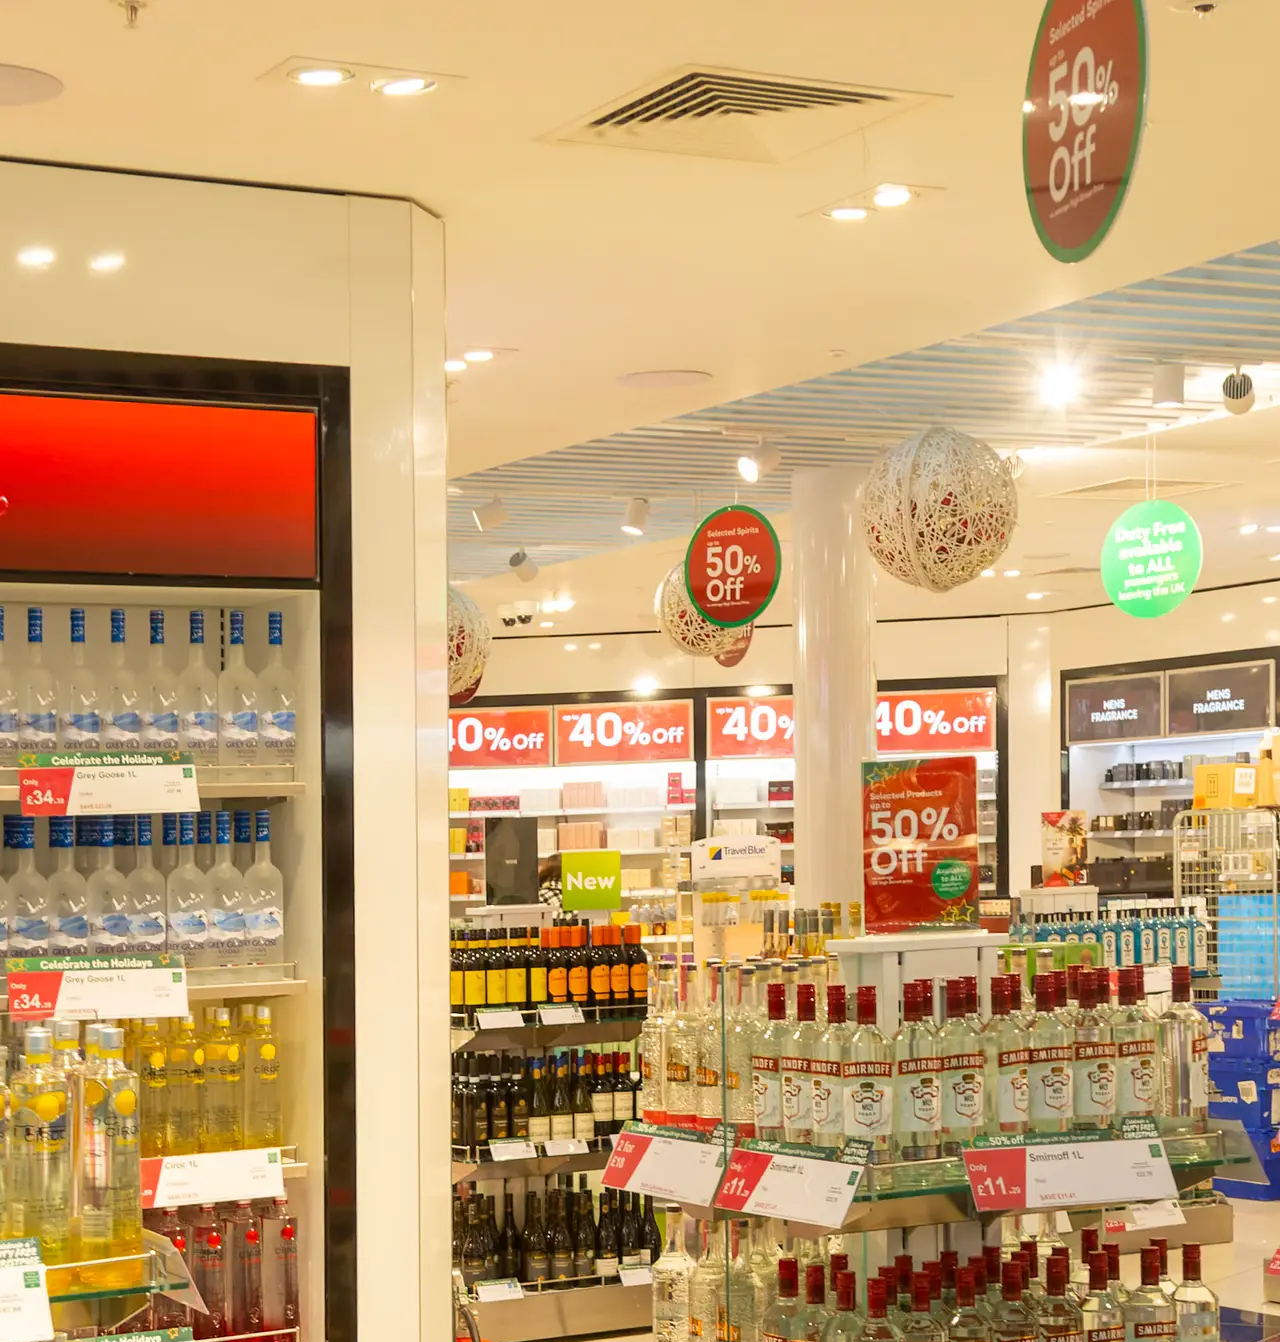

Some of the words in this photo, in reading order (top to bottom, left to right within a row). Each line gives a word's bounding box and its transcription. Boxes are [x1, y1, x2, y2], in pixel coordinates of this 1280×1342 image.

[1049, 6, 1086, 45] Selected
[1048, 46, 1119, 142] 50%
[1049, 124, 1097, 203] Off
[707, 528, 736, 538] Selected
[737, 526, 760, 537] Spirits
[706, 544, 761, 578] 50%
[1128, 562, 1145, 577] to
[1146, 555, 1176, 574] ALL
[706, 576, 745, 602] Off
[1206, 688, 1231, 701] MENS
[1103, 699, 1126, 710] MENS
[1193, 699, 1246, 714] FRAGRANCE
[1091, 709, 1138, 723] FRAGRANCE
[51, 756, 102, 767] Celebrate
[103, 756, 120, 765] the
[121, 755, 163, 766] Holidays
[76, 772, 96, 781] Grey
[98, 771, 126, 779] Goose
[23, 779, 39, 788] Only
[870, 791, 905, 801] Selected
[906, 789, 943, 800] Products
[870, 802, 881, 811] up
[871, 807, 959, 846] 50%
[871, 842, 929, 876] Off
[567, 872, 616, 891] New
[951, 874, 963, 882] ALL
[40, 960, 91, 971] Celebrate
[92, 959, 109, 969] the
[111, 958, 153, 969] Holidays
[65, 976, 85, 985] Grey
[87, 975, 114, 983] Goose
[844, 1062, 890, 1076] SMIRNOFF
[1011, 1135, 1025, 1145] off
[1029, 1152, 1069, 1163] Smirnoff
[1072, 1151, 1084, 1160] 1L
[164, 1160, 187, 1171] Ciroc
[969, 1164, 987, 1173] Only
